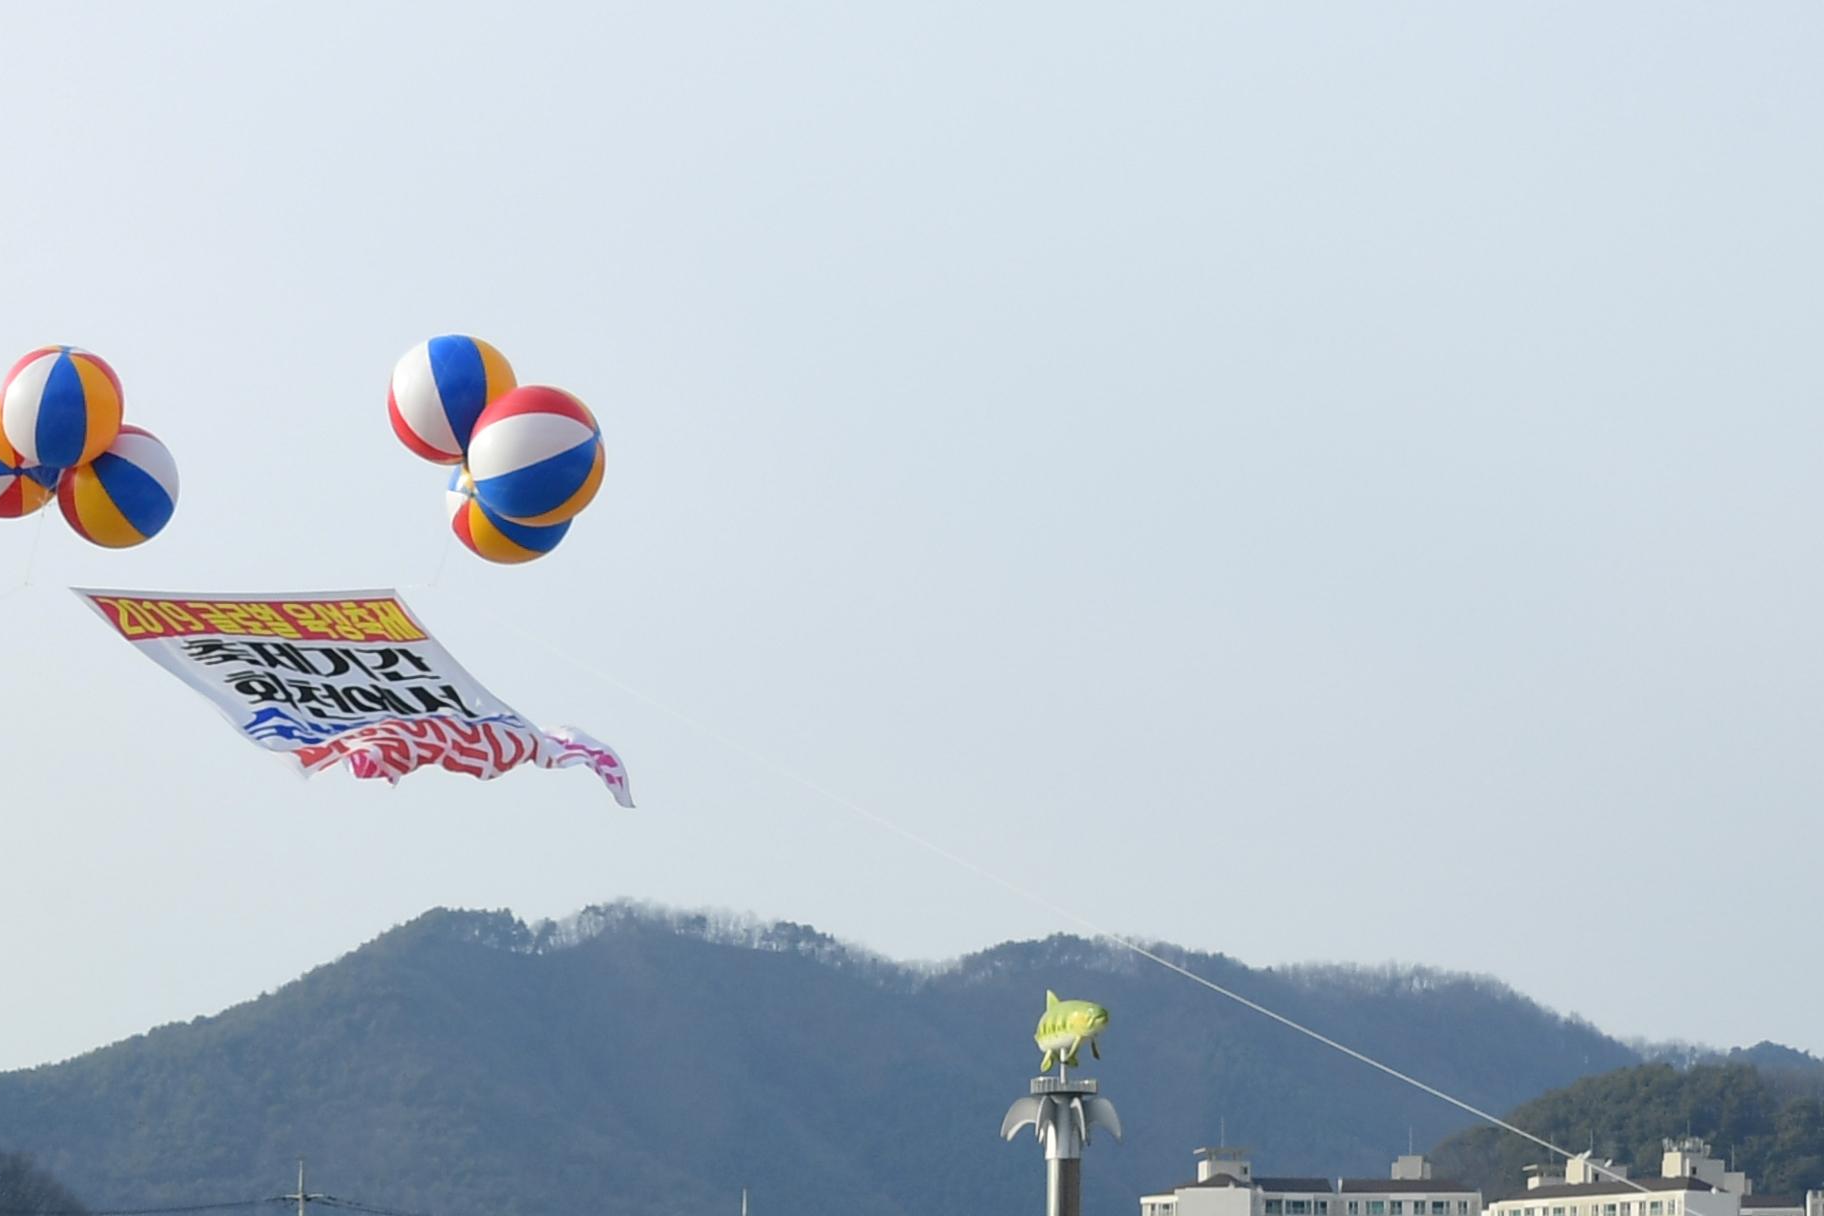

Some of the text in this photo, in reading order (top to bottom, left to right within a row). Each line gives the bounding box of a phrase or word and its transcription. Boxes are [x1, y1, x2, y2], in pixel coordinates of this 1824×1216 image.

[96, 598, 206, 635] 2019
[182, 638, 439, 681] 축제기간
[225, 671, 477, 719] 화천에서
